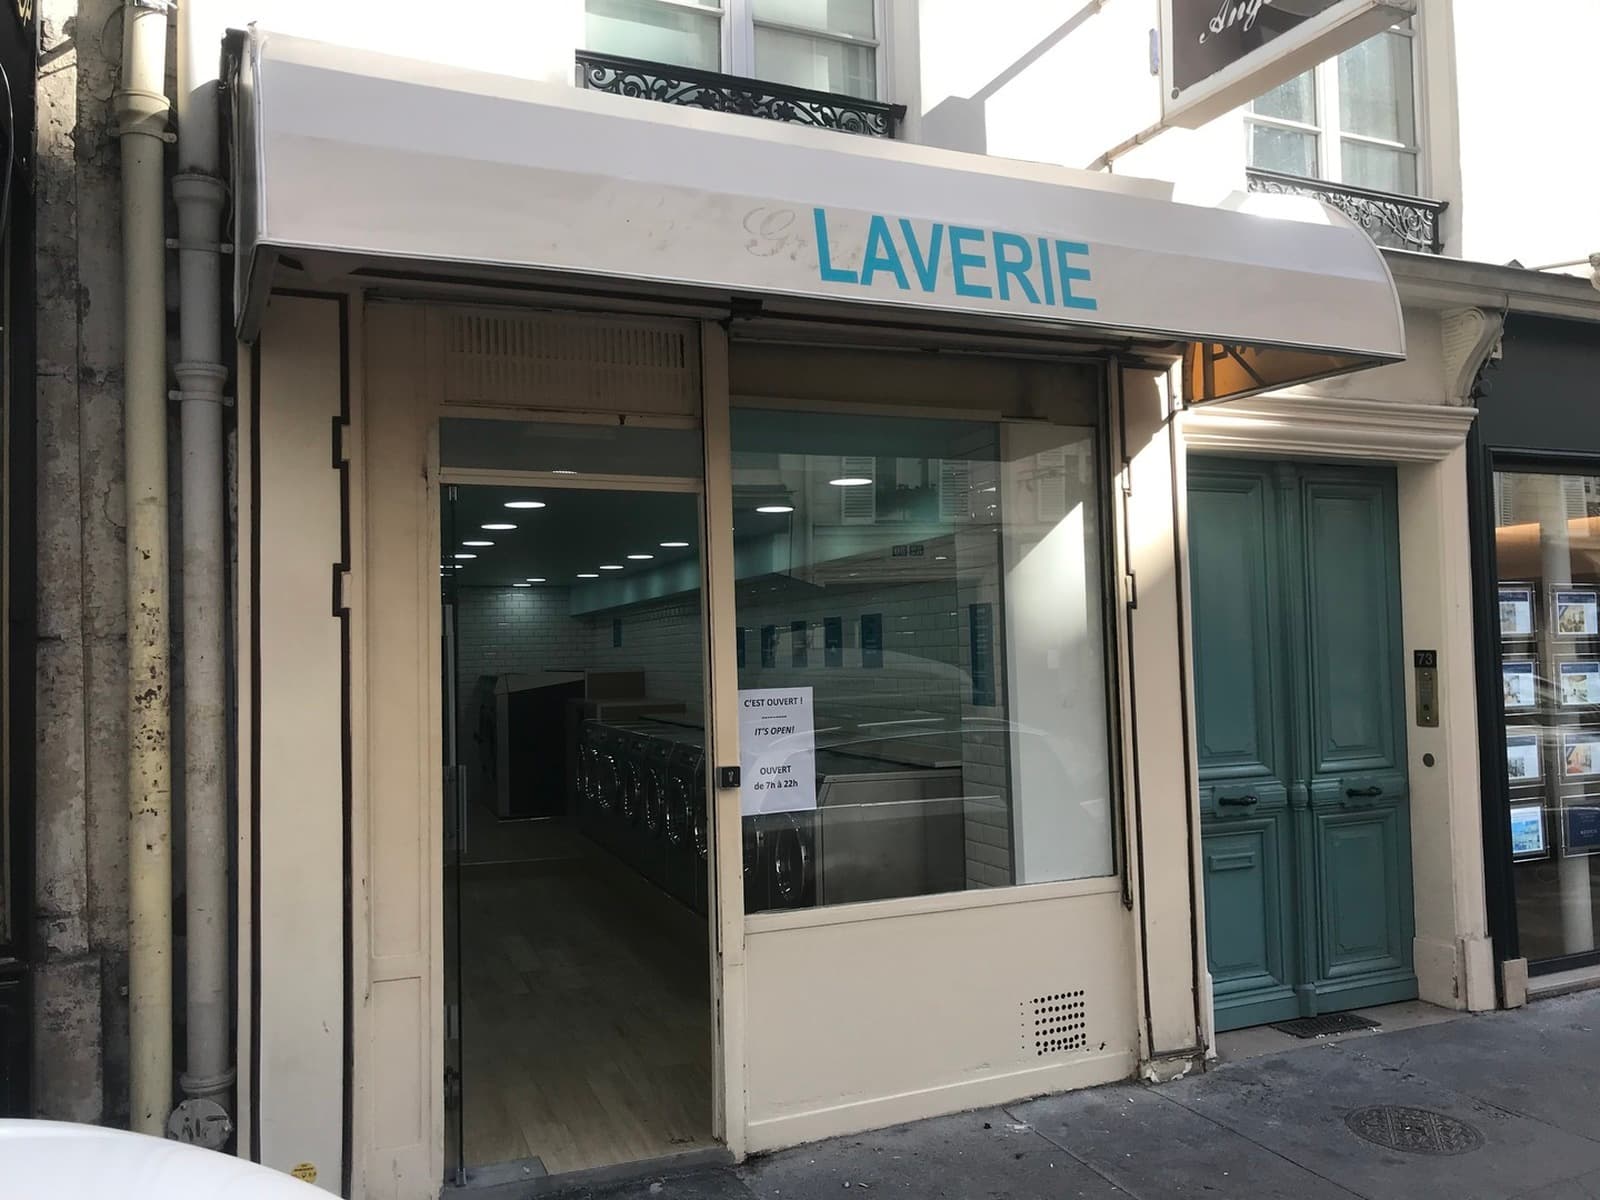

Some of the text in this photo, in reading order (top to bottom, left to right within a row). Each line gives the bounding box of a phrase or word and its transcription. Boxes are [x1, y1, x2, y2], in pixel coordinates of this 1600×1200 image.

[813, 207, 1097, 310] LAVERIE
[1416, 653, 1433, 665] 73
[743, 699, 765, 708] C'EST
[766, 697, 798, 706] OUVERT
[754, 725, 795, 736] IT'S OPEN!
[760, 765, 792, 775] OUVERT
[754, 779, 799, 790] de 7h à 22h
